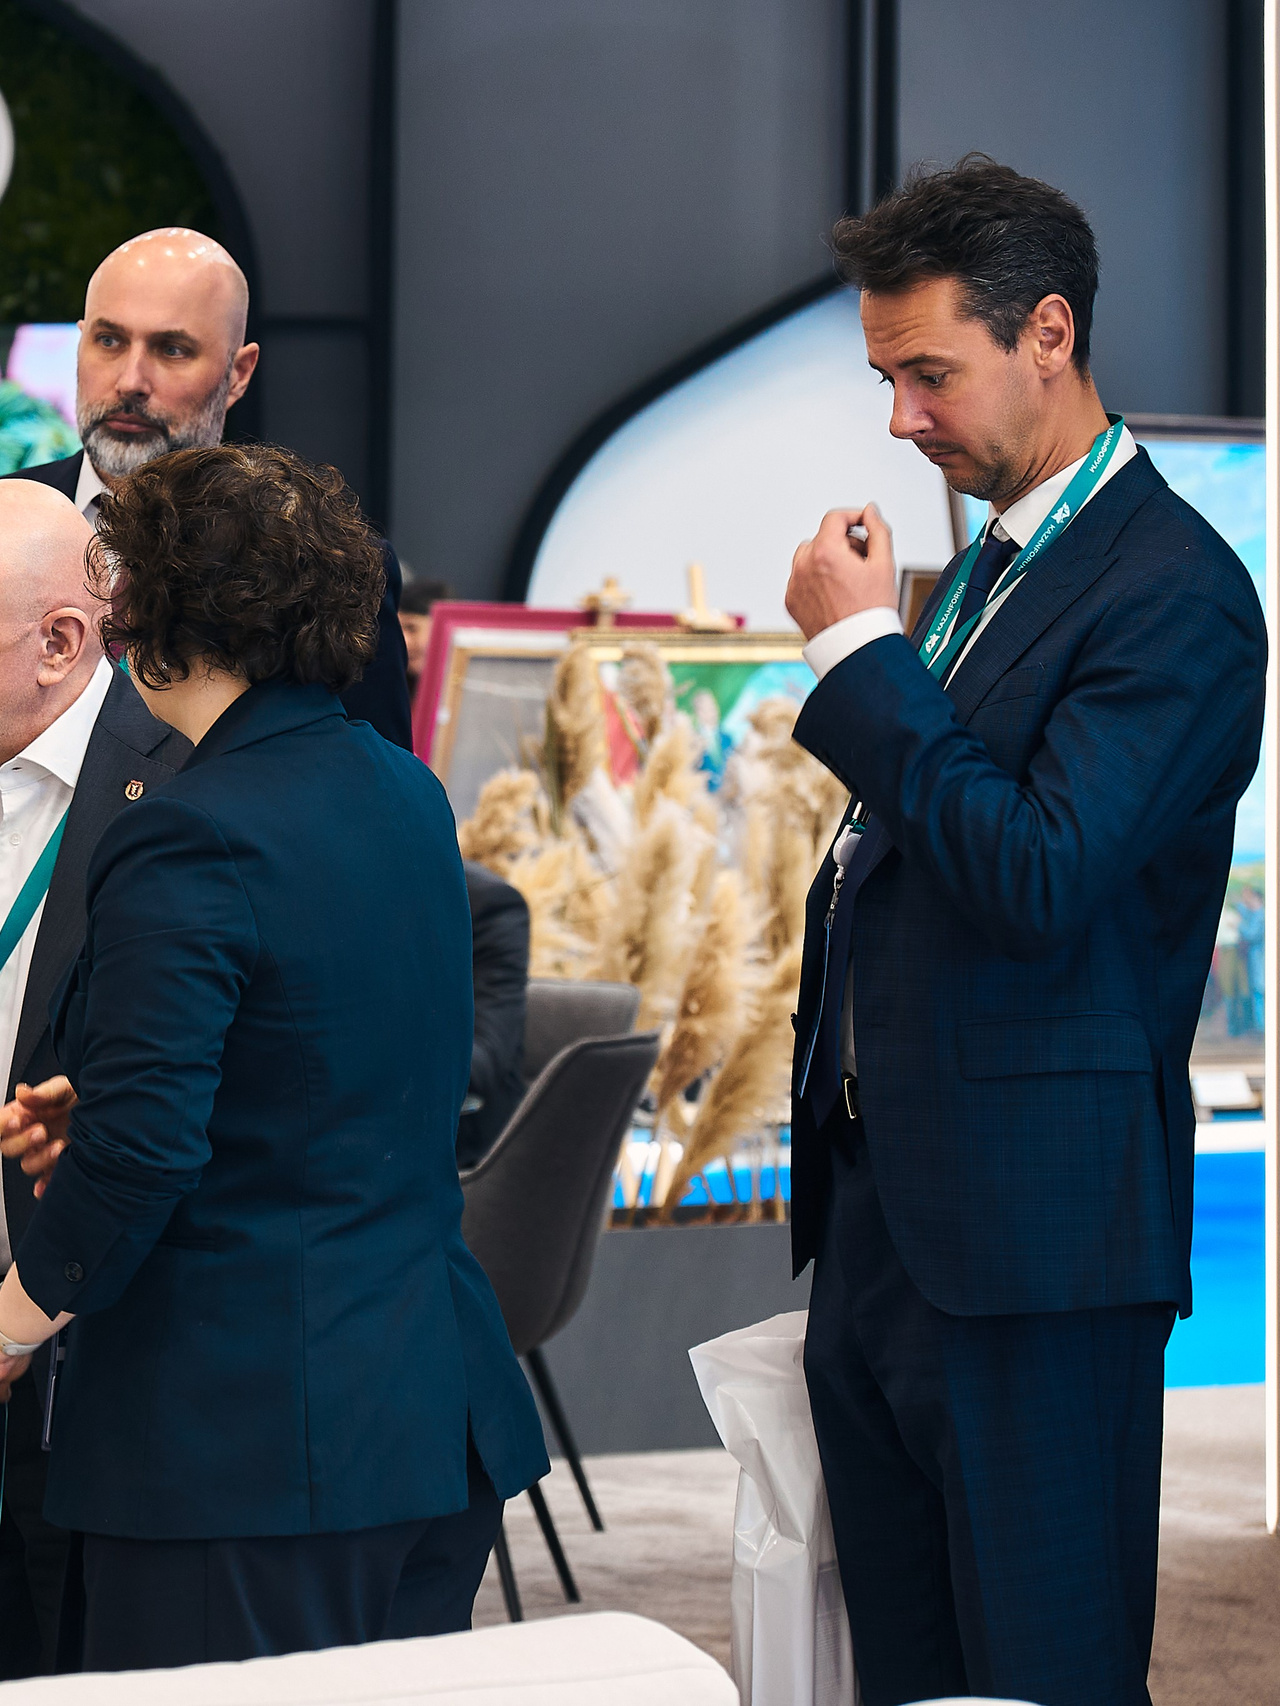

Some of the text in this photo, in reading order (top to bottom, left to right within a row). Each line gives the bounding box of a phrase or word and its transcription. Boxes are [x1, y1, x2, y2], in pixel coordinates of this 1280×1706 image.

[1089, 426, 1115, 473] ЗАНЬФОРУМ
[1016, 523, 1056, 572] KAZANFORUM
[936, 581, 967, 632] KAZANFORUM
